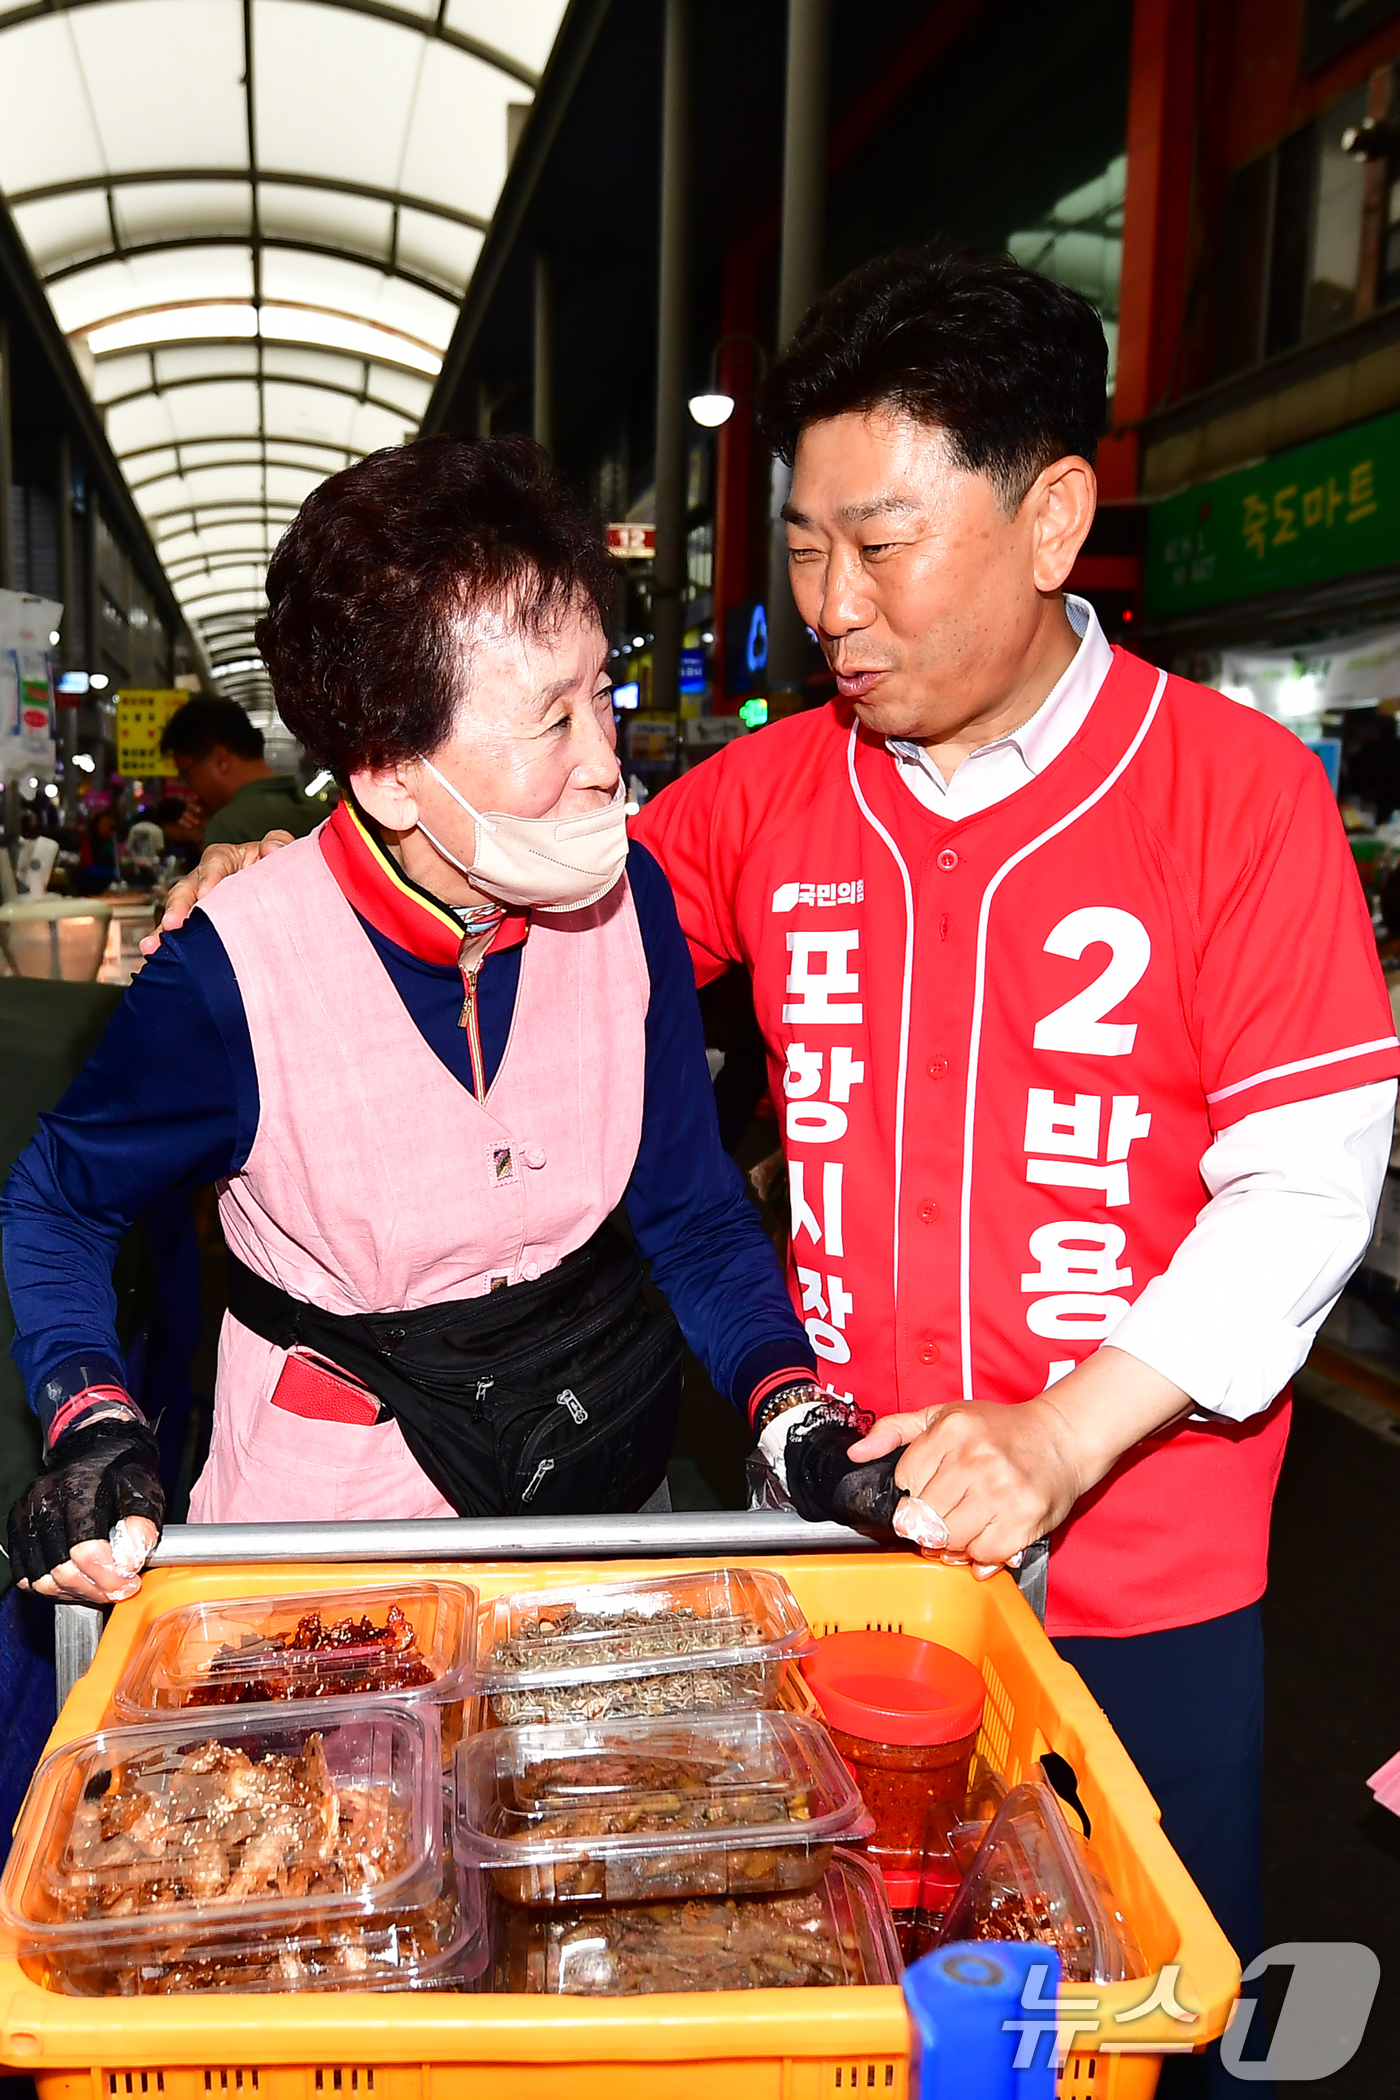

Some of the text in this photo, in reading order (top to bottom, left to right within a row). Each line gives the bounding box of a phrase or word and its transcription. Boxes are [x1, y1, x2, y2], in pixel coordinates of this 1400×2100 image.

[782, 929, 865, 1406] 포항시장
[1020, 905, 1152, 1393] 2 박용
